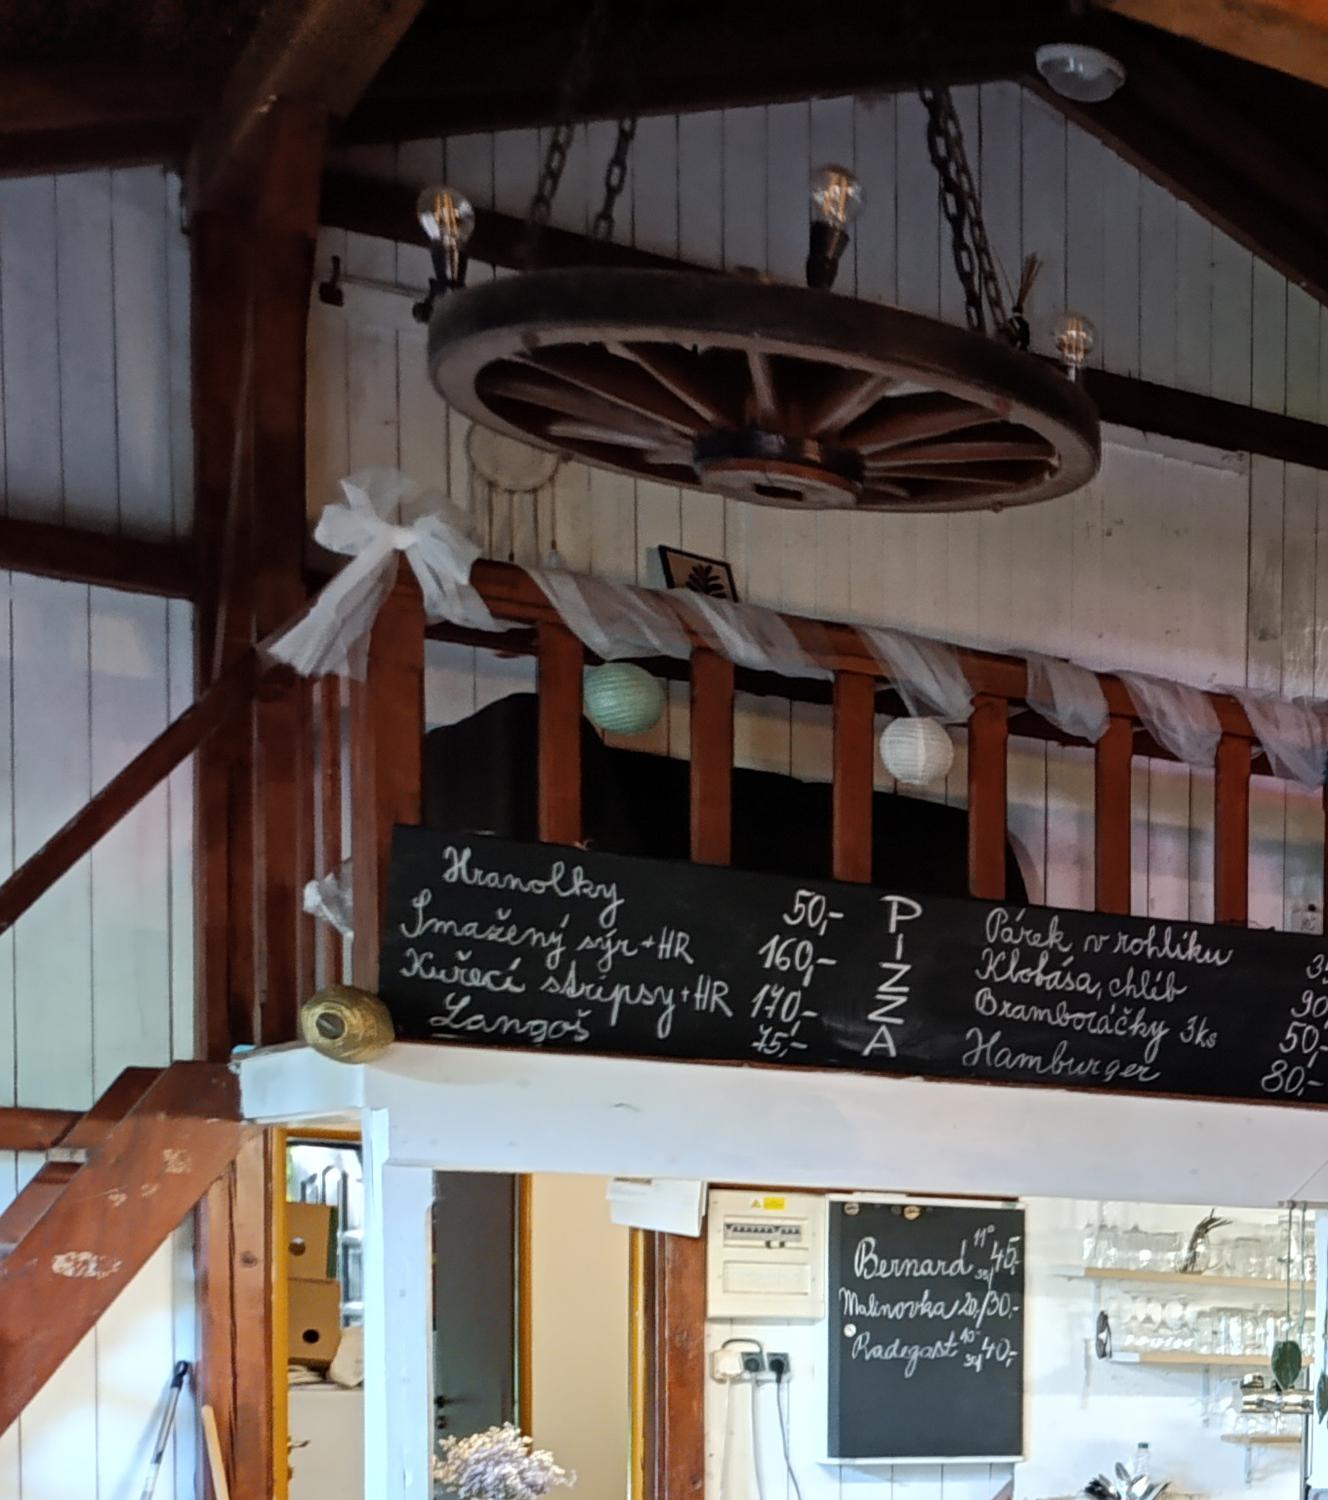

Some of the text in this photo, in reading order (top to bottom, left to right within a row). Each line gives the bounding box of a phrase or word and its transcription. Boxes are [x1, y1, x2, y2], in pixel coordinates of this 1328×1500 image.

[443, 845, 625, 929] Hranolky
[400, 888, 570, 970] Smažený
[984, 906, 1073, 954] Párek
[1114, 923, 1234, 967] rohlíku
[400, 948, 526, 993] Kuřecí
[430, 992, 592, 1043] Langoš
[974, 986, 1170, 1063] Bramboráčky
[962, 1026, 1162, 1083] Hamburger
[853, 1236, 974, 1280] Bernard
[838, 1287, 960, 1320] Malinovka
[852, 1331, 959, 1378] Radegast
